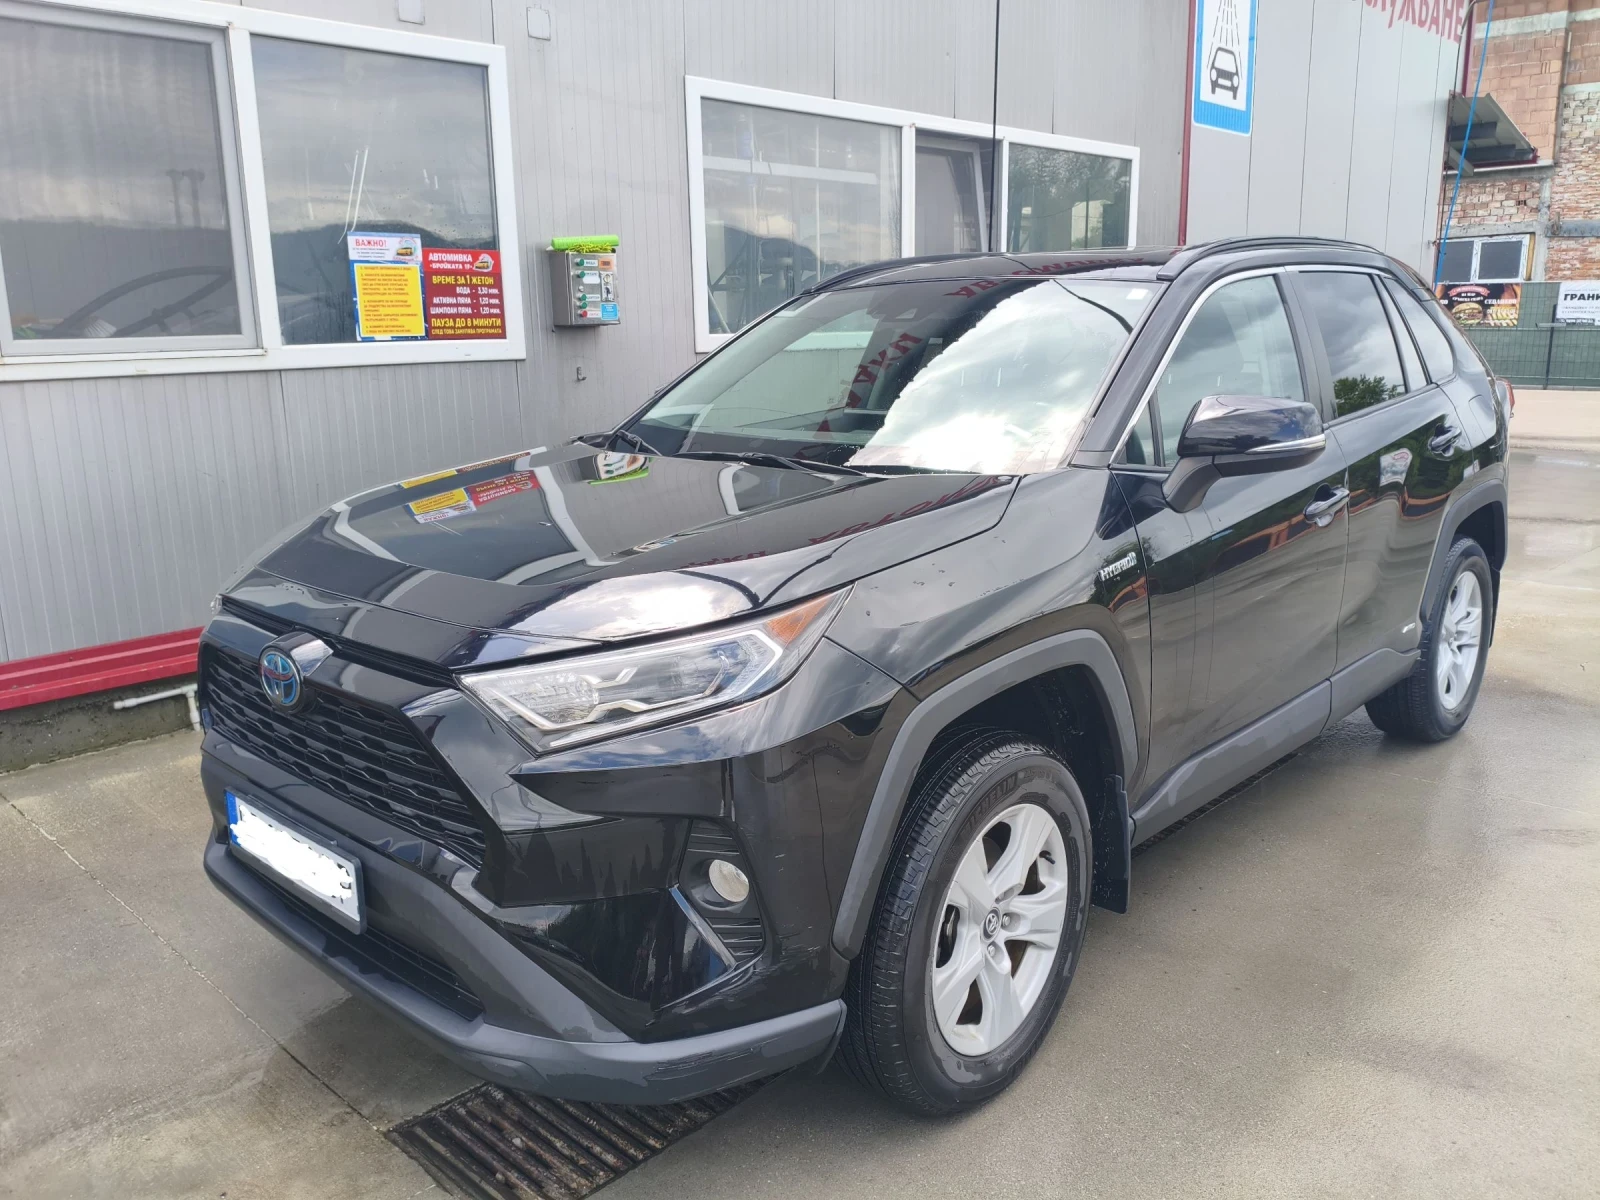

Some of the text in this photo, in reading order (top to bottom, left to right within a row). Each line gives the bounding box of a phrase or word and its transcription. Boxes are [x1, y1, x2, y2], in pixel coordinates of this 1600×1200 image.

[355, 239, 387, 247] ВАЖНО!
[428, 252, 472, 262] АВТОМИВКА
[432, 275, 494, 285] ВРЕМЕ ЗА 1 ЖЕТОН
[456, 286, 471, 294] ВОДА
[433, 296, 457, 304] АКТИВНА
[431, 318, 502, 328] ПАУЗА ДО 8 МИНУТИ
[1098, 556, 1131, 582] HYBRID
